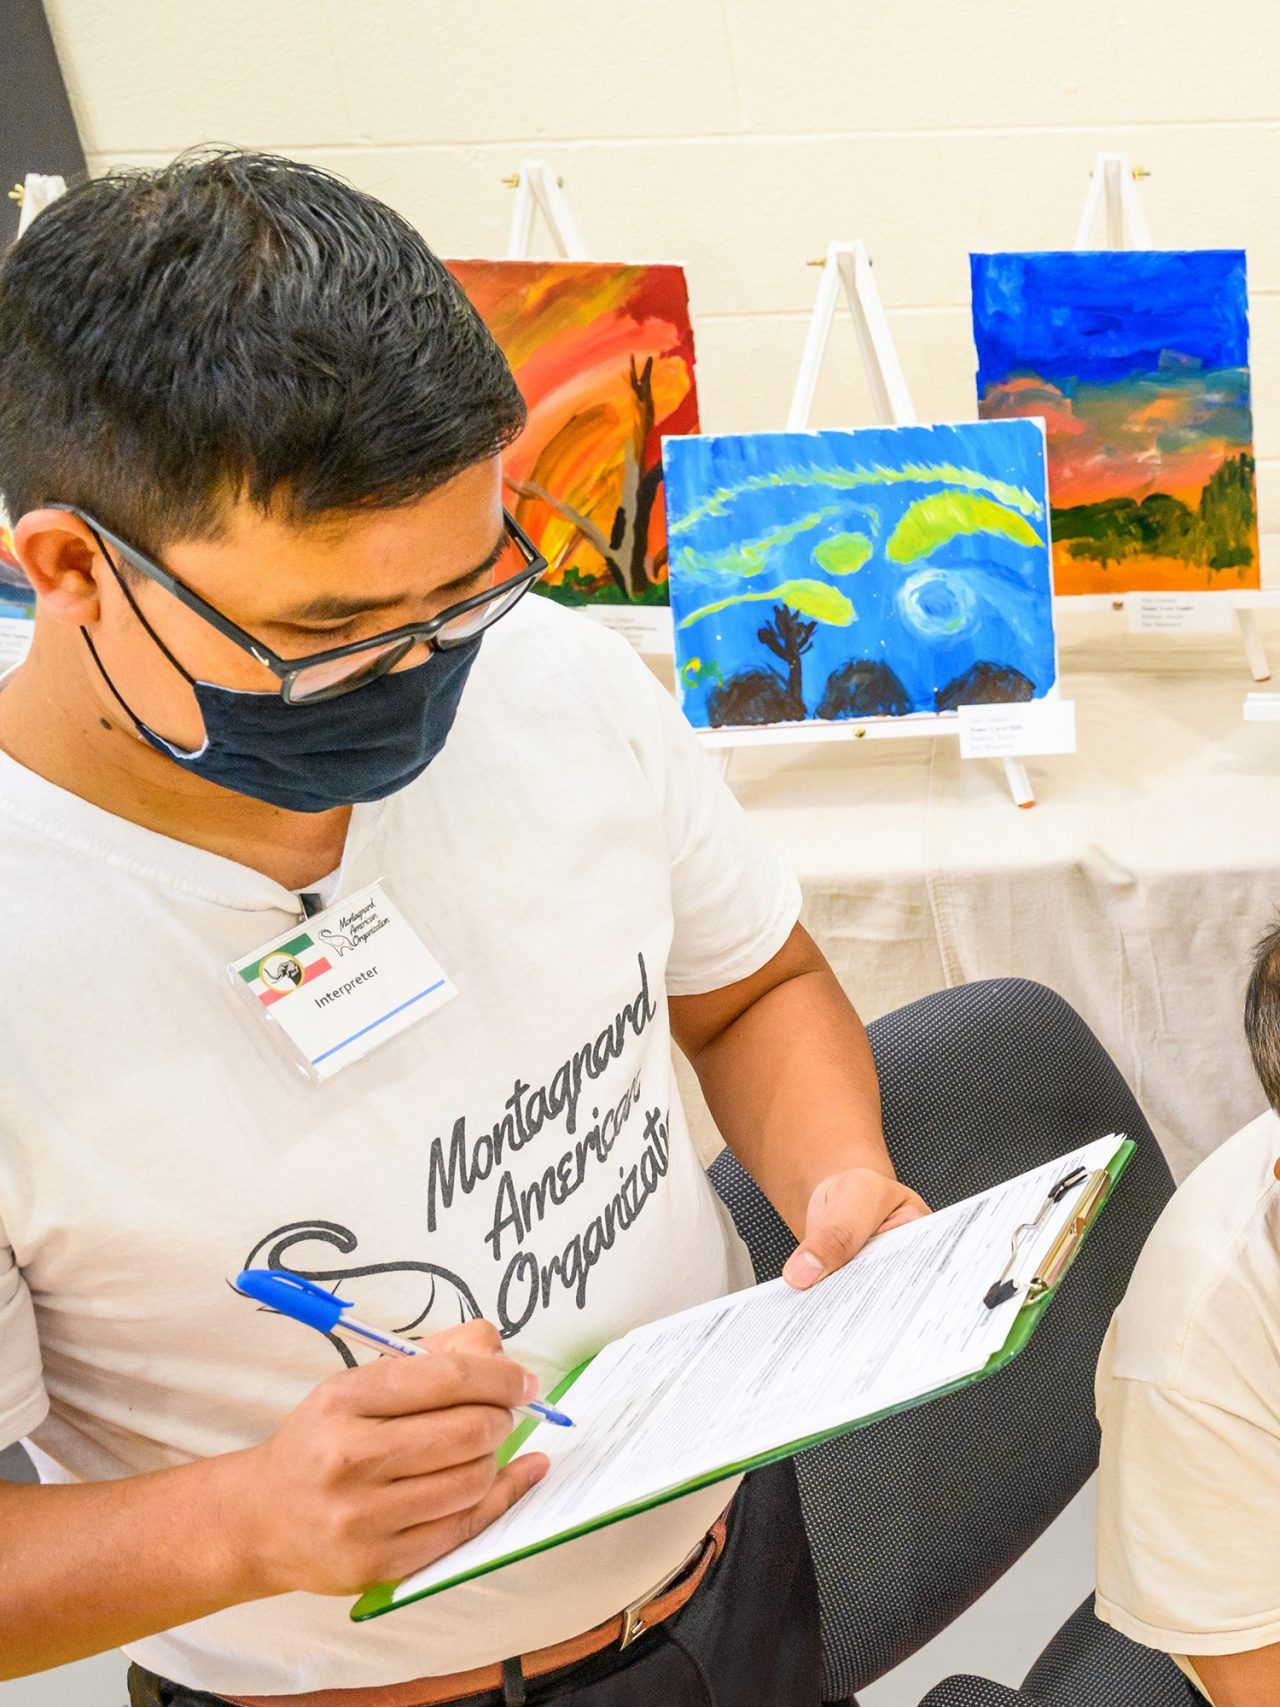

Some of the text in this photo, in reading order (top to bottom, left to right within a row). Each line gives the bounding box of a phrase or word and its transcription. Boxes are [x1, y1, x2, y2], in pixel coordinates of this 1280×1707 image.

[314, 965, 380, 1008] Interpreter
[427, 953, 657, 1233] Montagnard
[498, 1107, 670, 1335] Organizat
